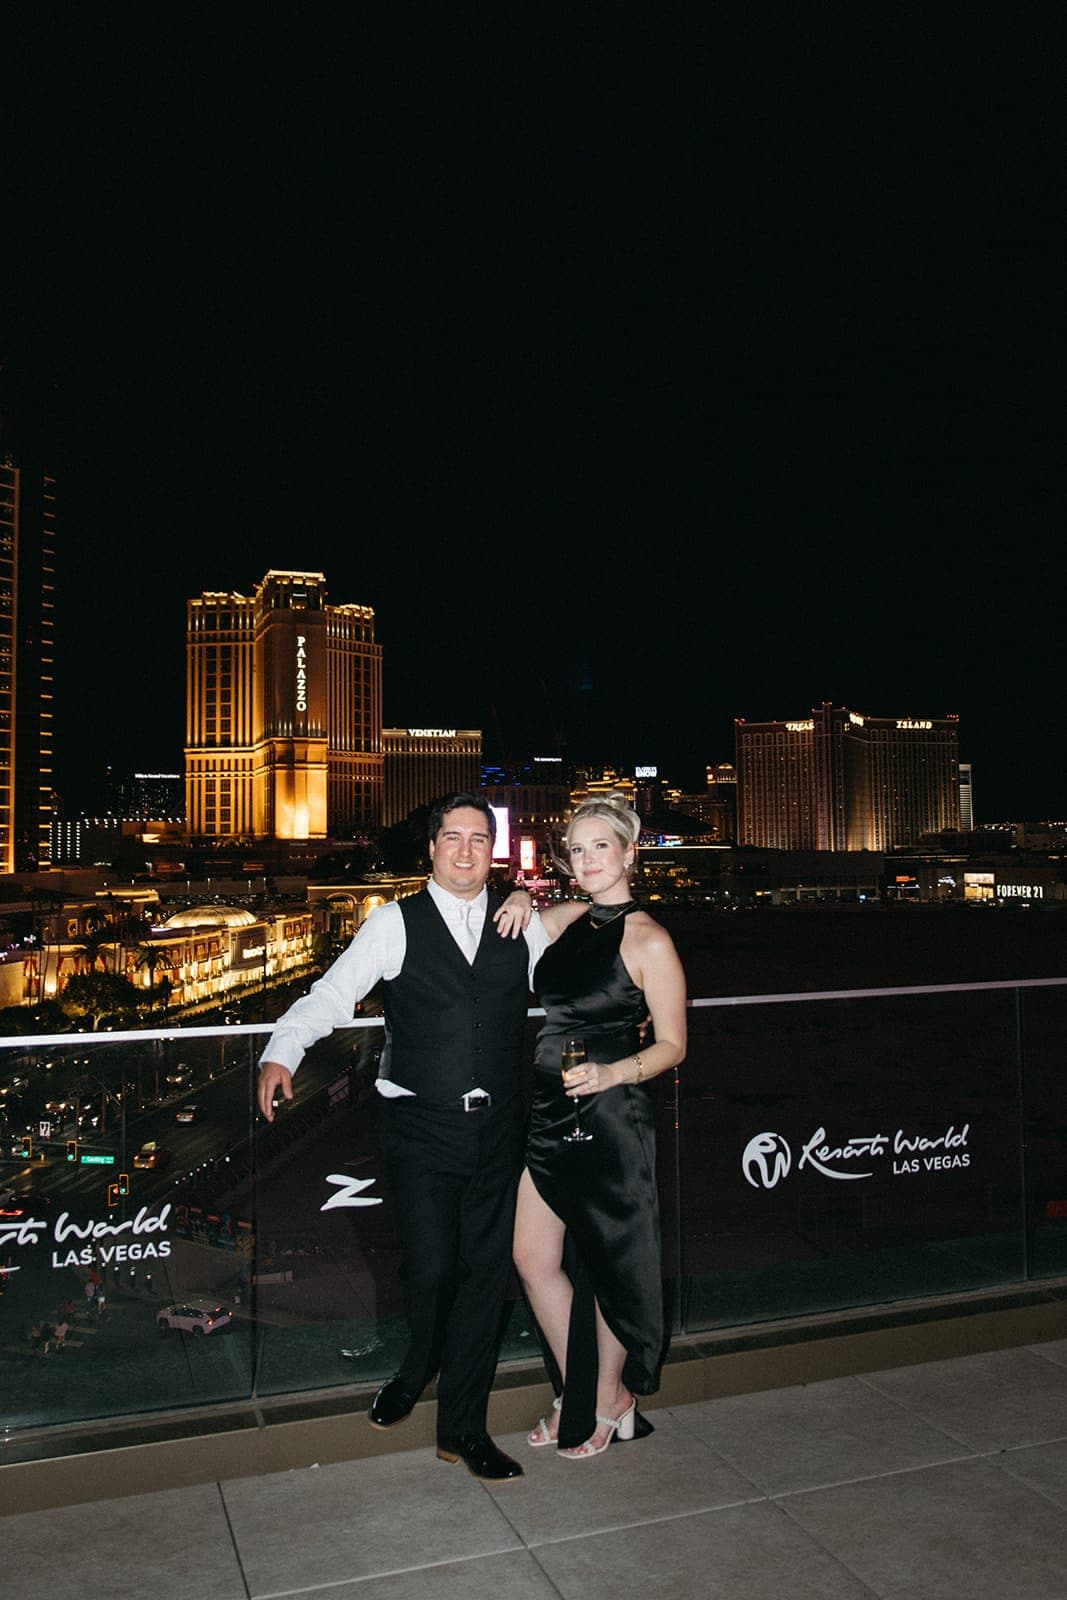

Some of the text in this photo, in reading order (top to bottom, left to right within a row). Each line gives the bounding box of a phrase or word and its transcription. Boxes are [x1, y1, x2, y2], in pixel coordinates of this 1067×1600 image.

[296, 636, 307, 712] PALAZZO
[408, 729, 456, 737] VENETIAN
[896, 721, 933, 729] ISLAND
[997, 884, 1043, 898] FOREVER 21
[798, 1123, 969, 1180] Resorts World
[893, 1154, 970, 1174] LAS VEGAS
[54, 1203, 172, 1242] World
[52, 1241, 171, 1268] LAS VEGAS
